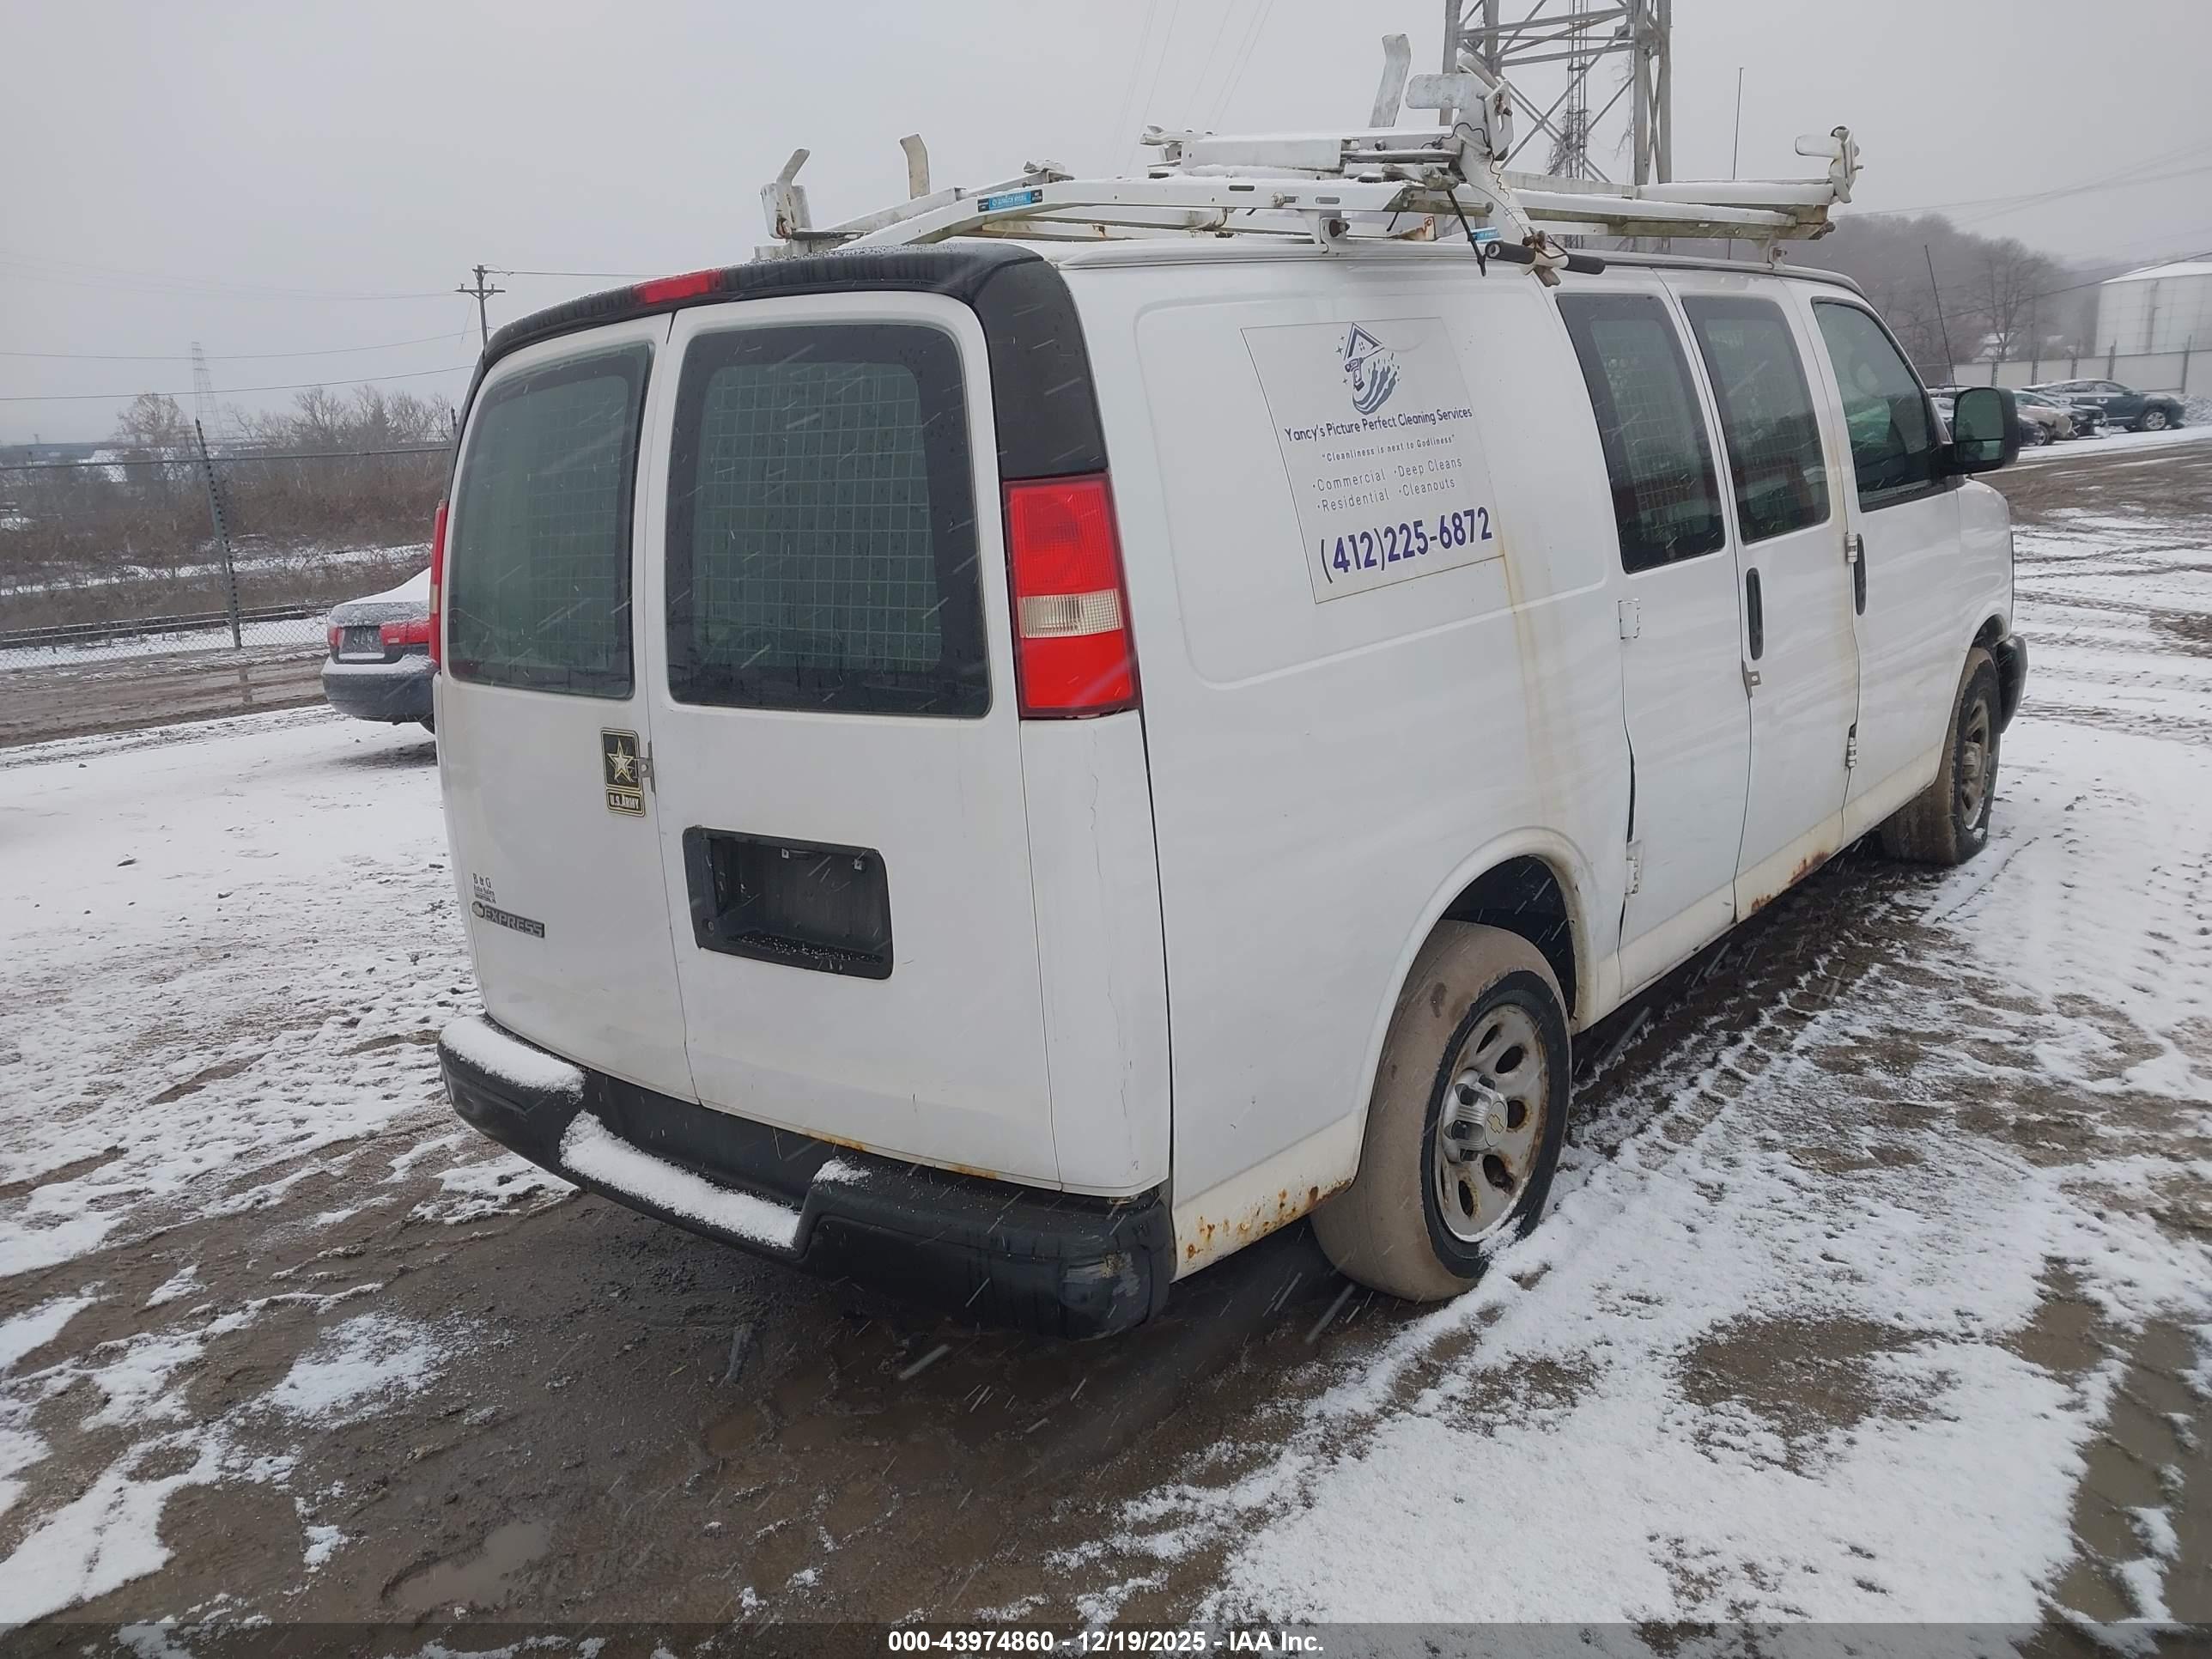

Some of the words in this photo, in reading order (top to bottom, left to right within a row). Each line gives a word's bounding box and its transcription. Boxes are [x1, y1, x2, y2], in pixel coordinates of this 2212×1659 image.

[1285, 424, 1325, 441] Yancy's
[1326, 422, 1360, 436] Picture
[1362, 416, 1397, 431] Perfect
[1398, 410, 1436, 426] Cleaning
[1437, 407, 1473, 421] Services
[1377, 445, 1385, 454] is
[1387, 442, 1405, 453] next
[1407, 441, 1414, 450] to
[1427, 458, 1463, 472] Cleans
[1321, 507, 1492, 583] (412)225-6872
[484, 905, 544, 939] EXPRESS
